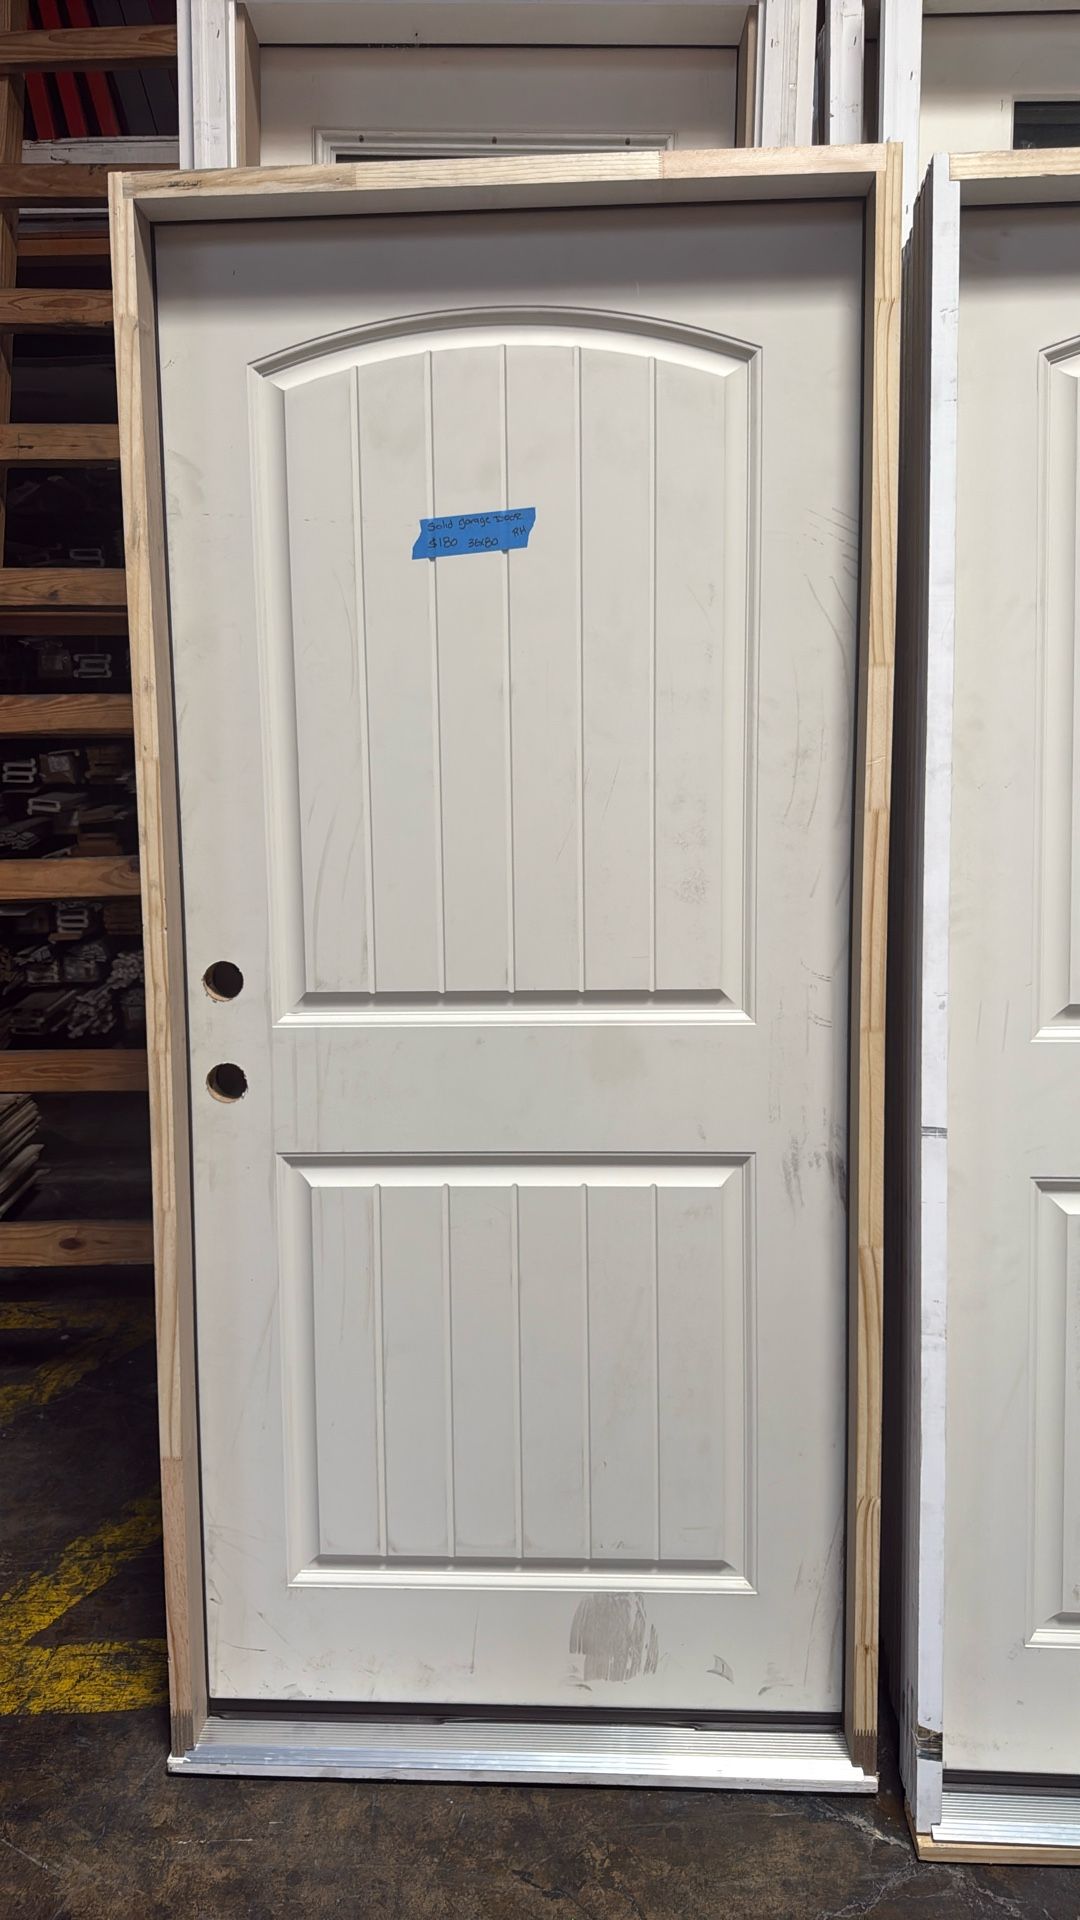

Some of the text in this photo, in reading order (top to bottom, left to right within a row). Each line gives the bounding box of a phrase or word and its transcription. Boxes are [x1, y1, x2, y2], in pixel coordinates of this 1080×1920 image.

[427, 519, 453, 531] Solid
[427, 536, 458, 549] $180
[512, 525, 527, 537] RH
